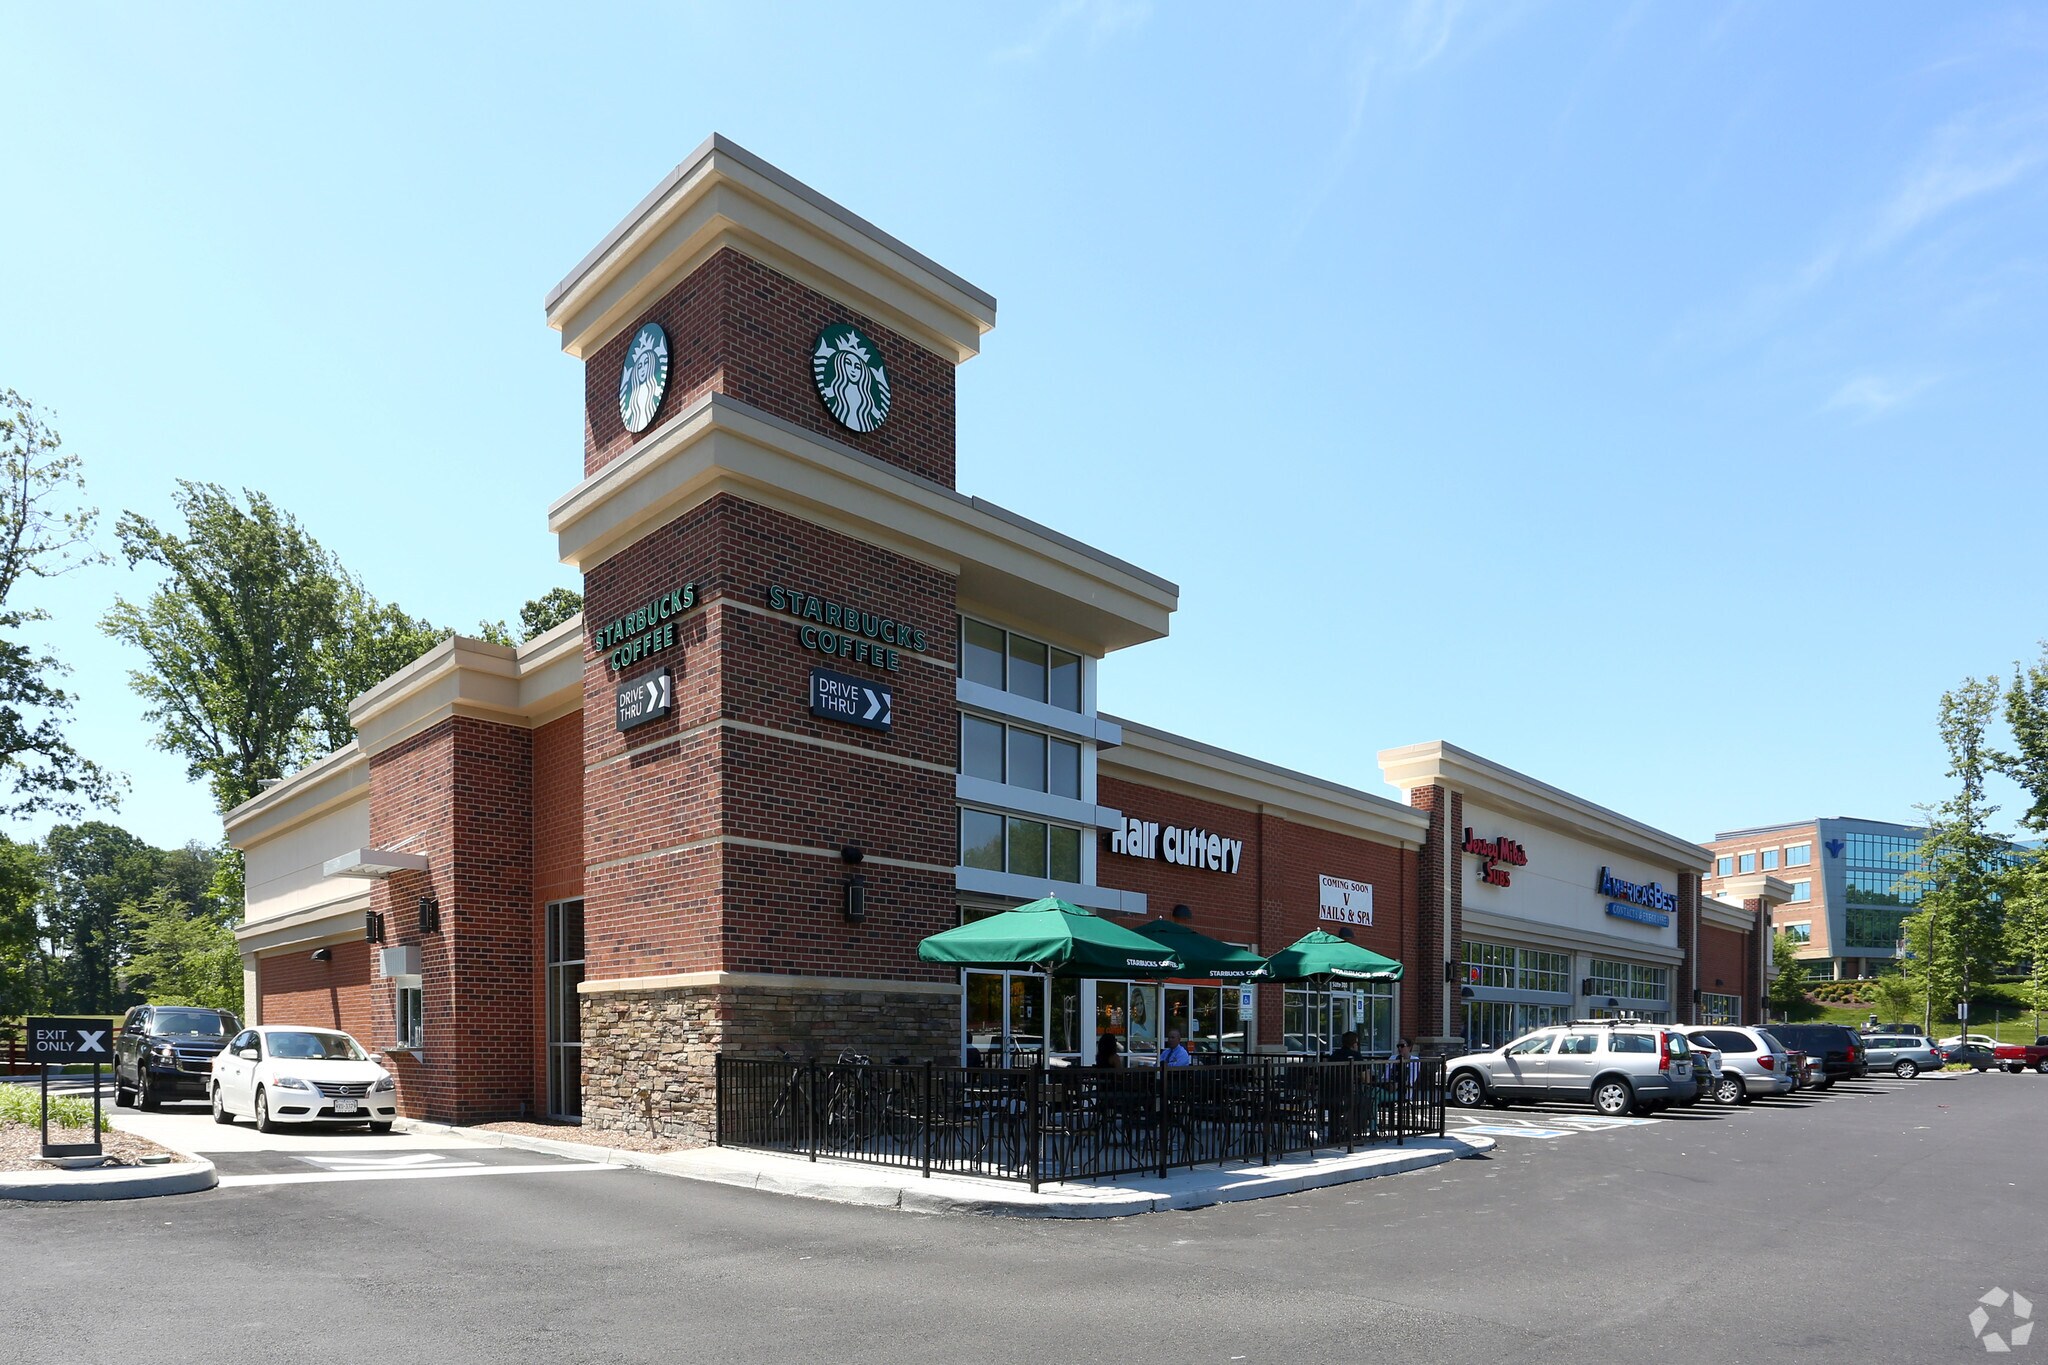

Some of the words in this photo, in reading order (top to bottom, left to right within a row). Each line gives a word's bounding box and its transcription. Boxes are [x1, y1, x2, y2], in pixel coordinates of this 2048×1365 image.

[594, 582, 695, 652] STARBUCKS
[769, 585, 928, 652] STARBUCKS
[611, 622, 674, 671] COFFEE
[800, 624, 900, 672] COFFEE
[619, 685, 644, 708] DRIVE
[819, 677, 859, 701] DRIVE
[619, 702, 642, 722] THRU
[819, 693, 856, 715] THRU
[1111, 816, 1159, 860] Hair
[1463, 827, 1499, 866] Jersey
[1322, 877, 1349, 890] COMING
[1350, 882, 1369, 894] SOON
[1343, 892, 1350, 906] V
[1320, 904, 1346, 921] NAILS
[1347, 909, 1355, 922] &
[1357, 910, 1370, 925] SPA
[1126, 958, 1158, 968] STARBUCKS
[36, 1029, 67, 1040] EXIT
[36, 1041, 75, 1052] ONLY
